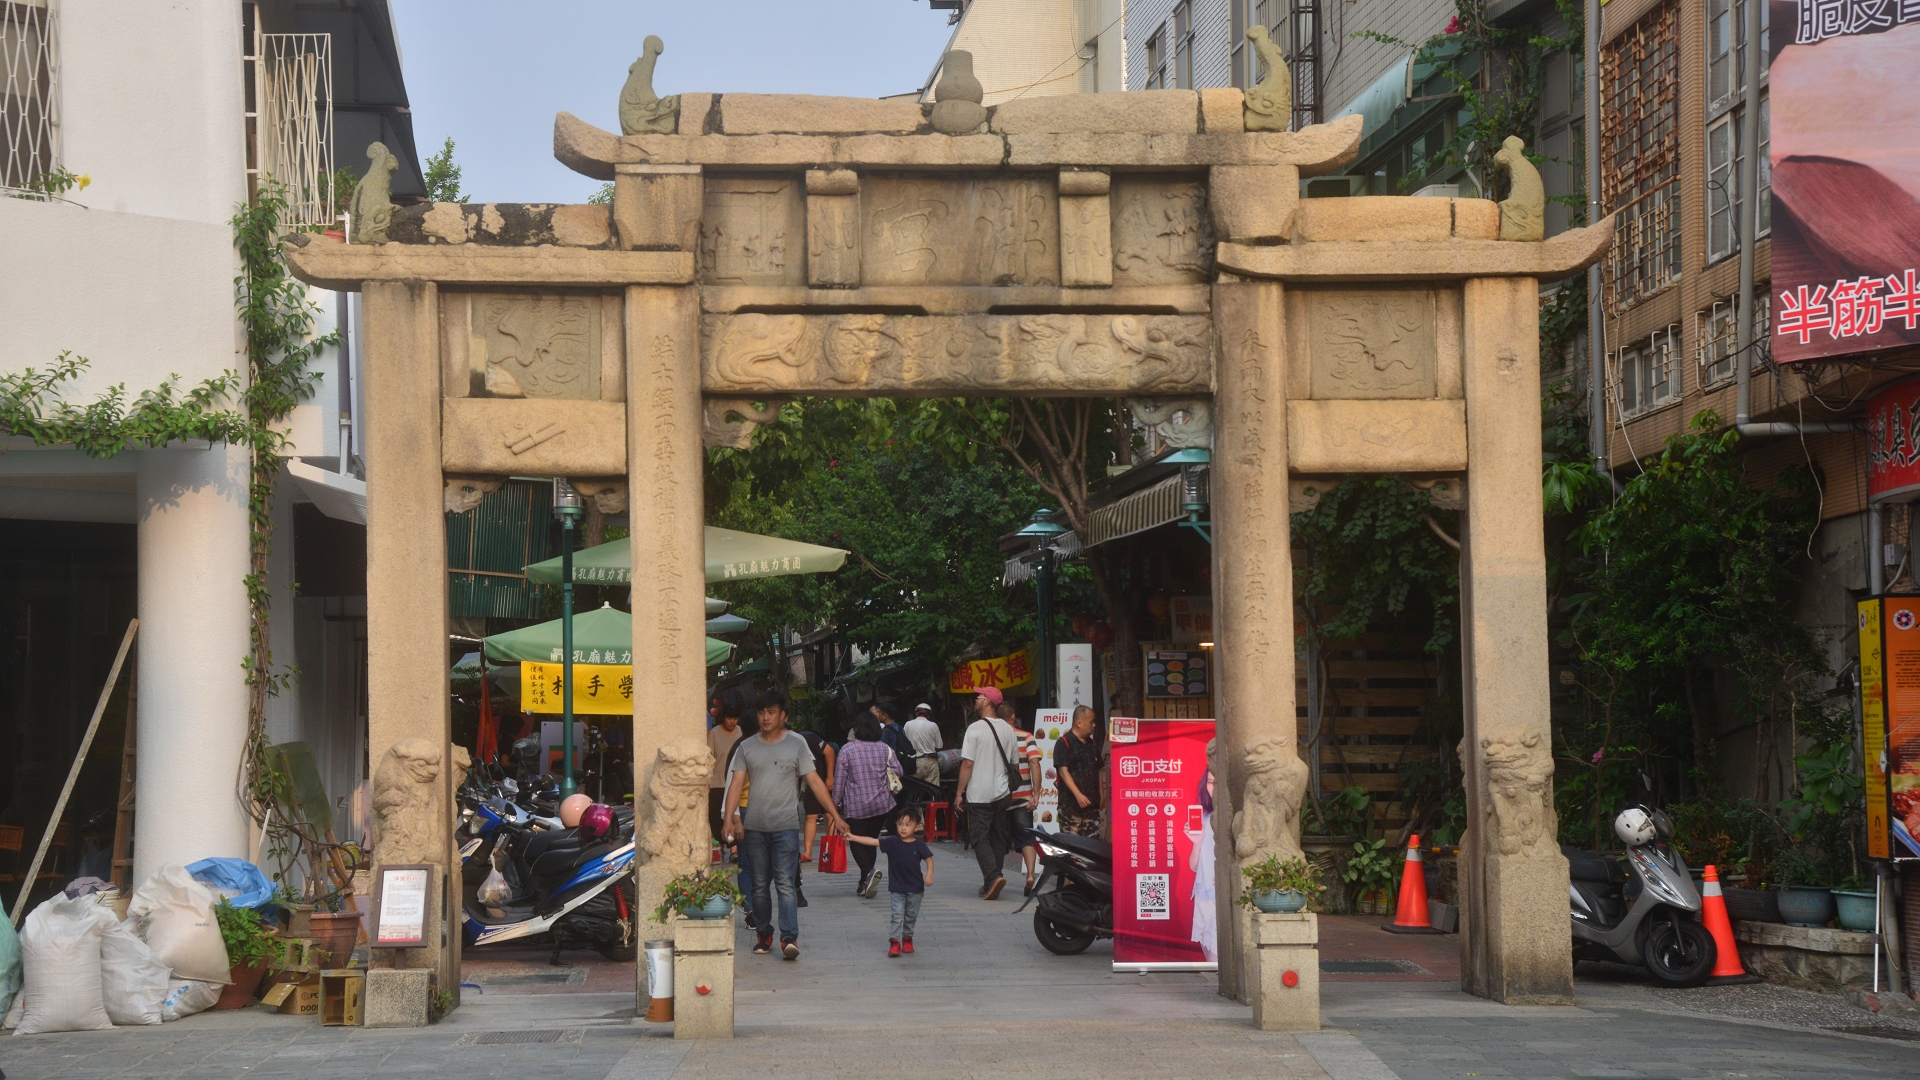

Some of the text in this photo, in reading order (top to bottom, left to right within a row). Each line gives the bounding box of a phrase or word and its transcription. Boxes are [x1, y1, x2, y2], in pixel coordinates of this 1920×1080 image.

[1043, 712, 1068, 724] meiji
[1121, 757, 1182, 777] 街口支付
